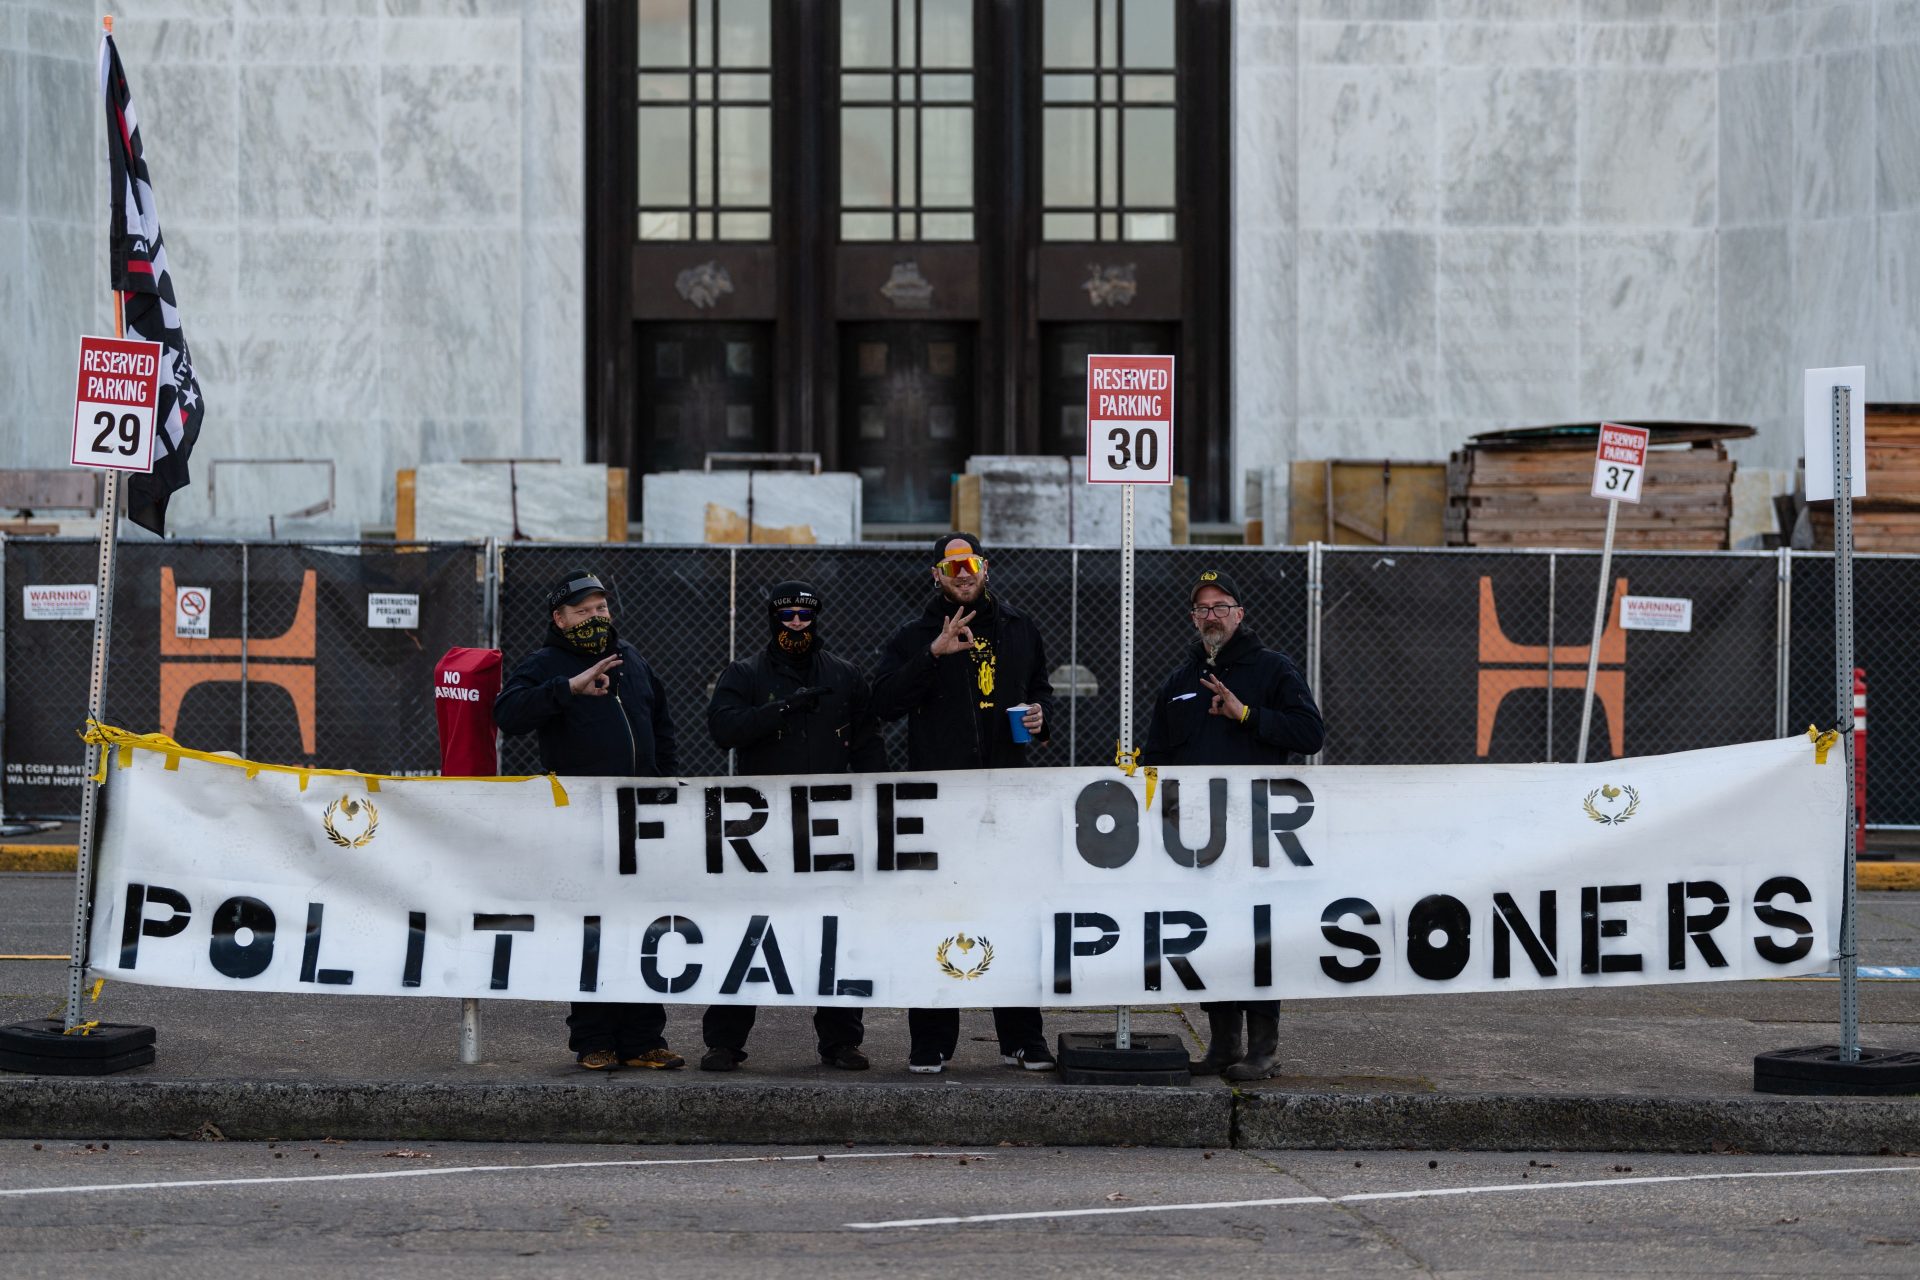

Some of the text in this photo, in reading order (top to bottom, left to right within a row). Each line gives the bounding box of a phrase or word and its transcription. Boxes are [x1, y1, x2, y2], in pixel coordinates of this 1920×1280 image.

[83, 350, 154, 376] RESERVED
[1093, 369, 1168, 390] RESERVED
[87, 377, 147, 402] PARKING
[1099, 395, 1161, 416] PARKING
[91, 411, 141, 456] 29
[1603, 430, 1644, 449] RESERVED
[1107, 428, 1158, 470] 30
[1603, 446, 1640, 464] PARKING
[1606, 467, 1634, 491] 37
[30, 590, 91, 602] WARNING!
[371, 597, 417, 606] CONSTRUCTION
[552, 588, 567, 605] GIRO
[773, 597, 819, 607] FUCK ANTIFA
[386, 617, 401, 625] ONLY
[177, 626, 207, 636] SMOKING
[444, 671, 461, 685] NO
[435, 686, 480, 702] ARKING
[6, 763, 23, 773] OR
[6, 775, 24, 785] WA
[53, 776, 84, 786] HOFF
[617, 777, 1314, 876] FREE OUR
[117, 876, 1814, 998] POLITICAL PRISONERS
